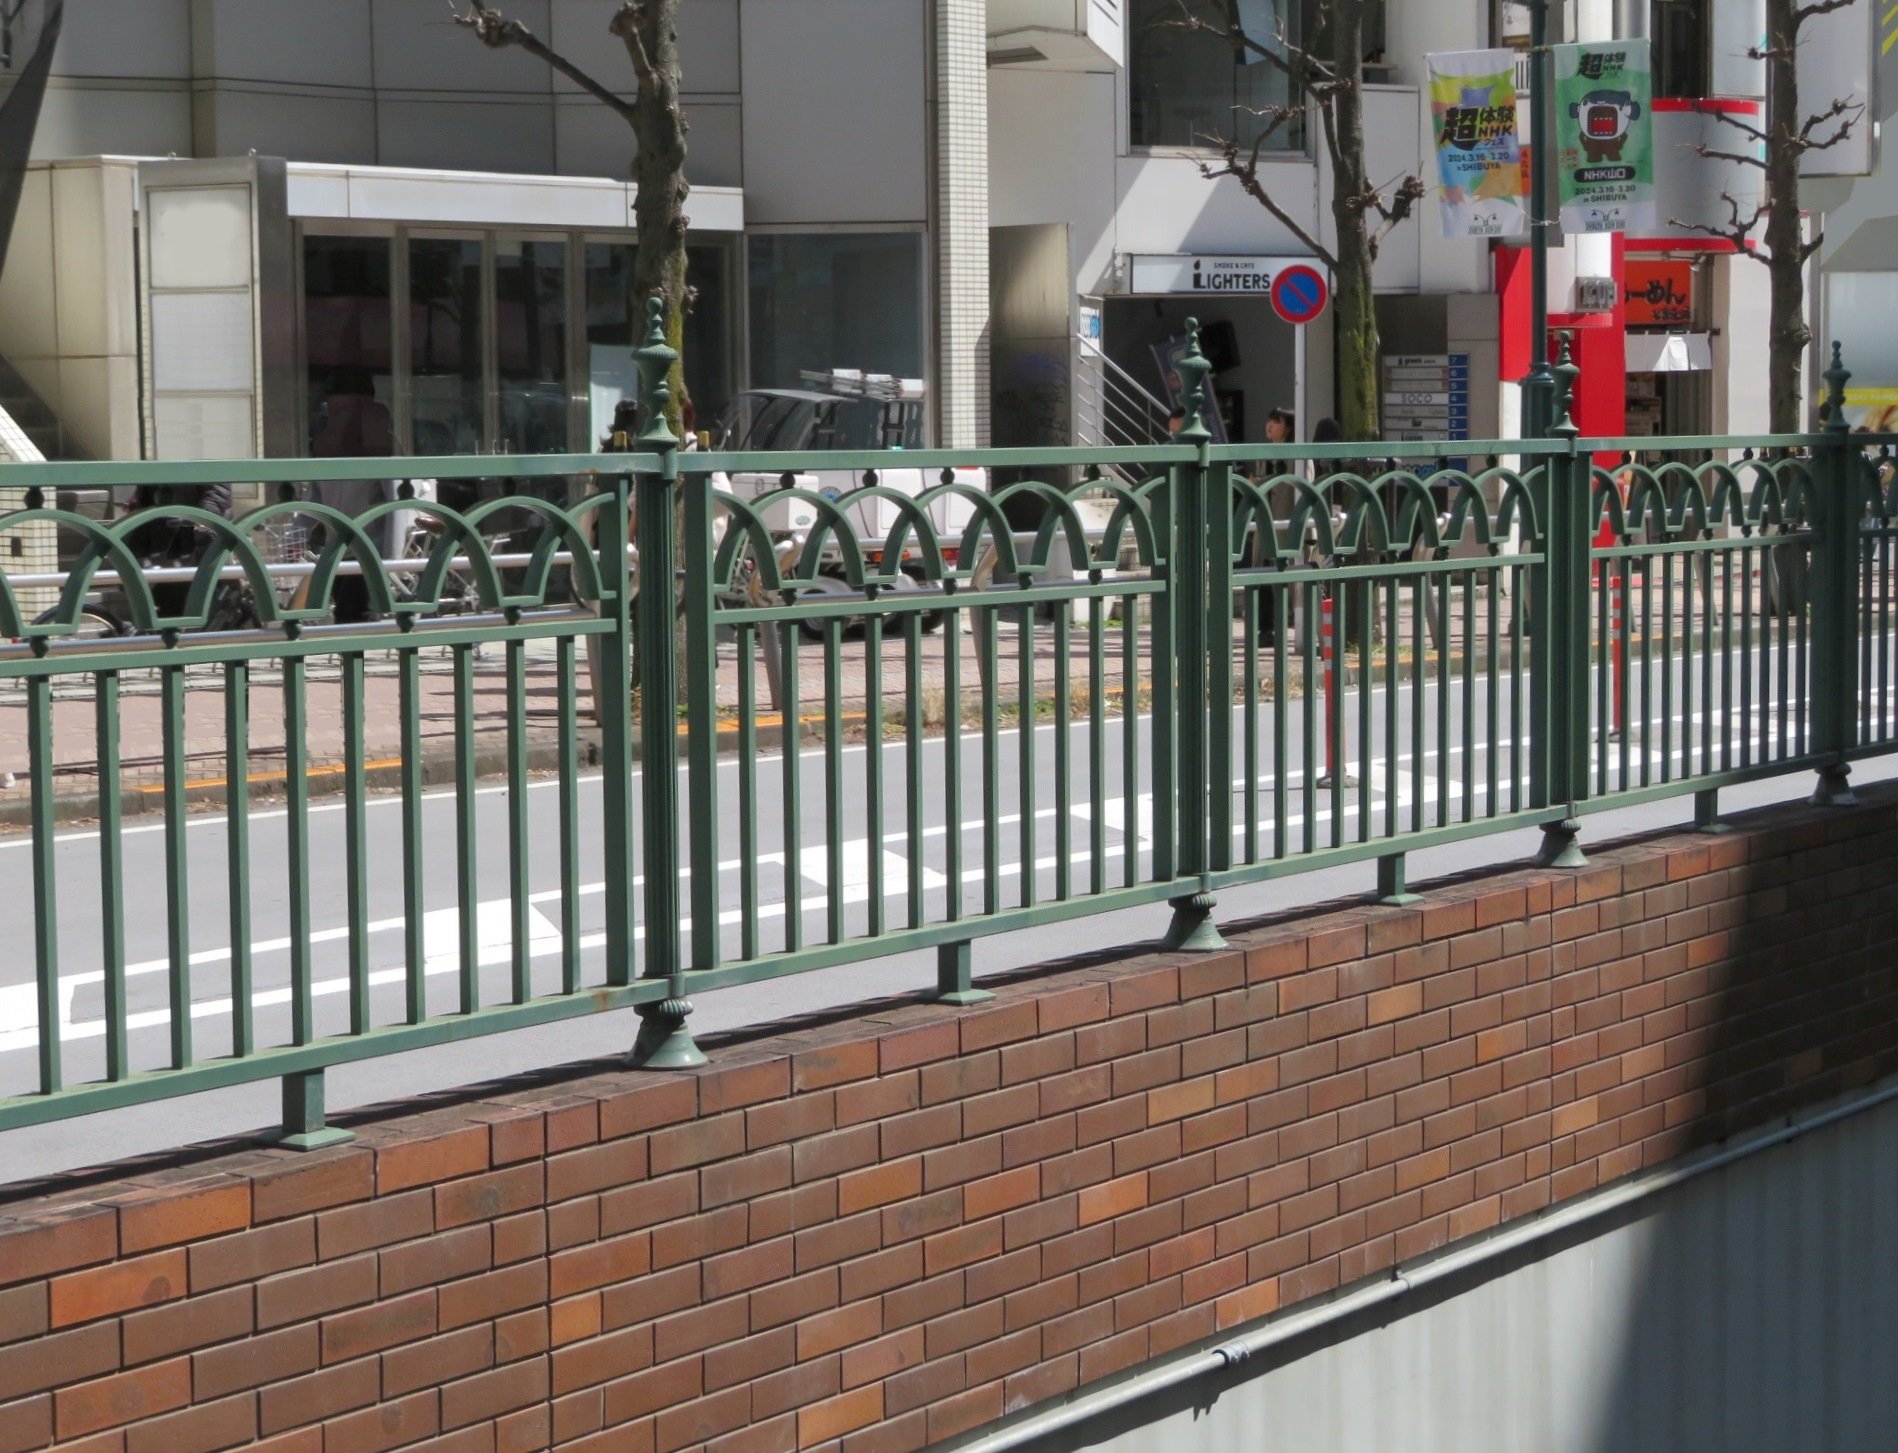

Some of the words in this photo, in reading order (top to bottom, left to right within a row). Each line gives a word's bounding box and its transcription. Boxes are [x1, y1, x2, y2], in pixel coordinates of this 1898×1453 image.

[1478, 124, 1513, 138] NHK
[1462, 162, 1502, 172] SHIBUYA
[1590, 193, 1627, 203] SHIBUYA
[1625, 279, 1686, 305] ーめん
